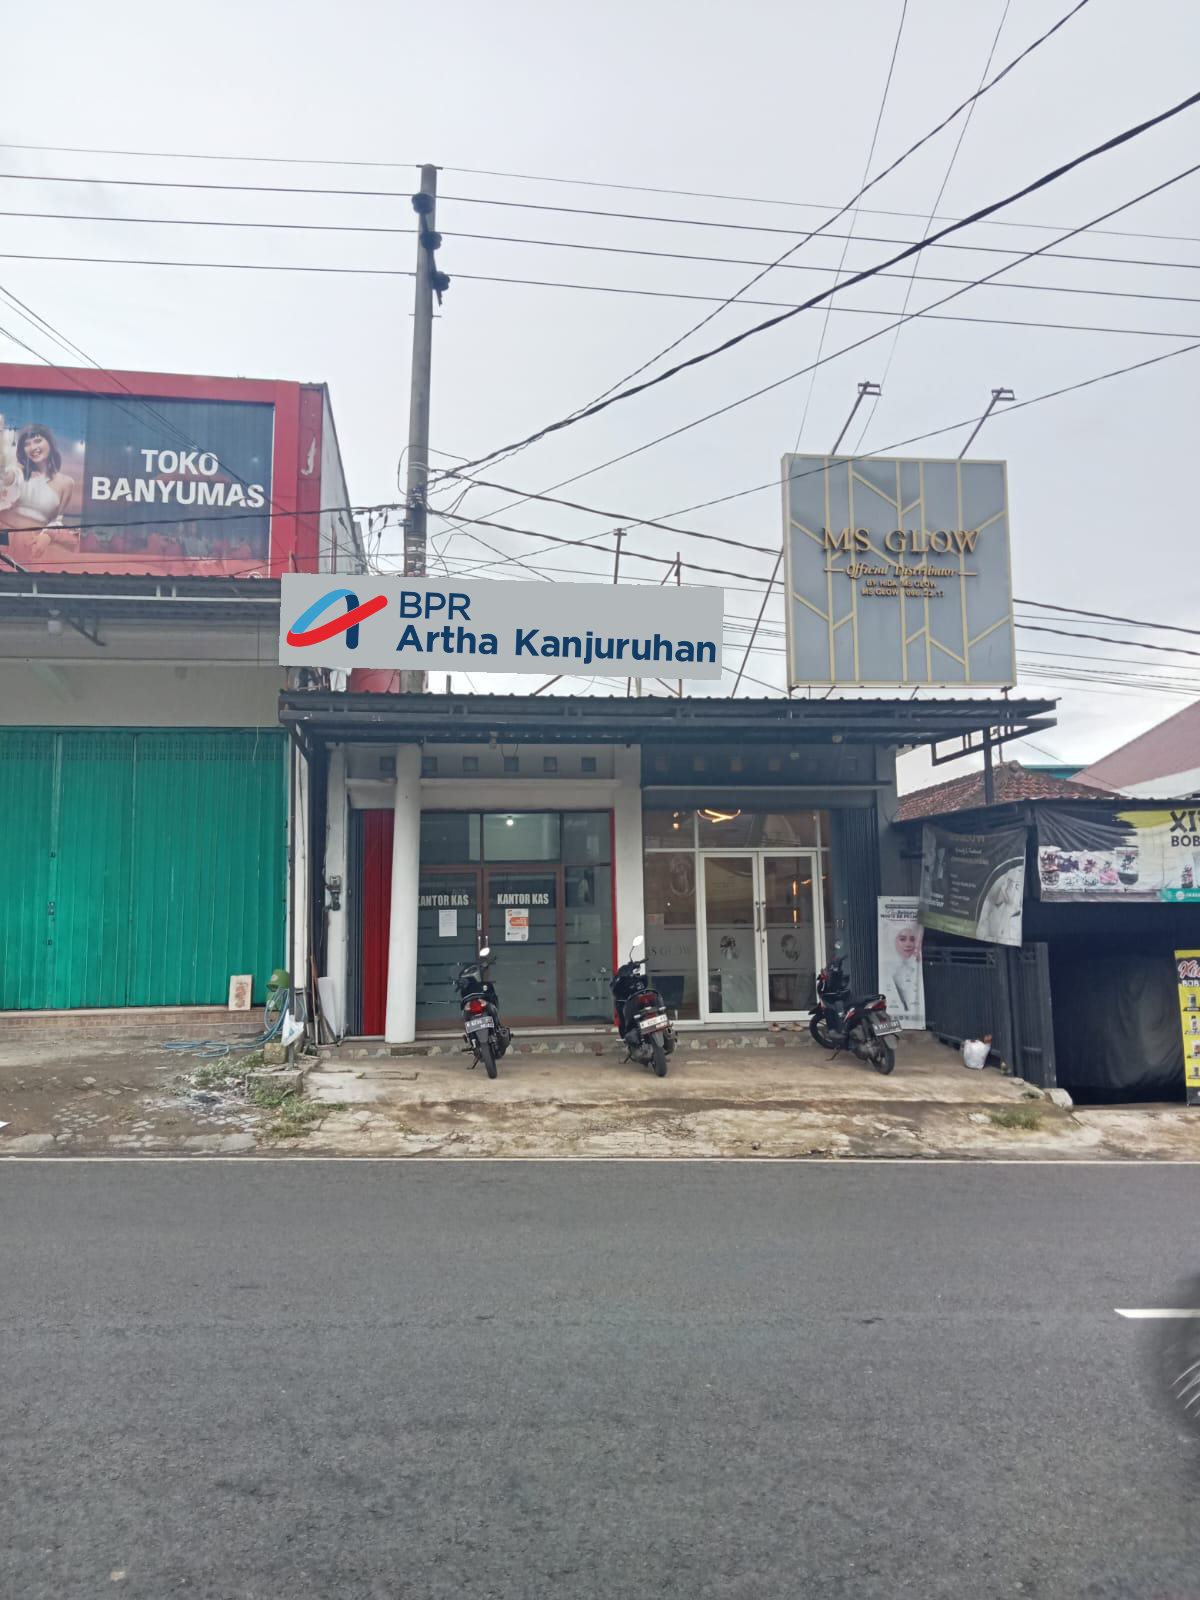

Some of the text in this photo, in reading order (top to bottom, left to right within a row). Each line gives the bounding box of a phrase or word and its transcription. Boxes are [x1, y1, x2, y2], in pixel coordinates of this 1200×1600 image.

[141, 448, 219, 475] TOKO
[91, 476, 265, 508] BANYUMAS
[822, 527, 980, 553] MS GLOW
[846, 562, 889, 579] Official
[399, 591, 471, 621] BPR
[396, 625, 717, 664] Artha Kanjuruhan
[1169, 810, 1200, 832] XI
[451, 894, 469, 906] KAS
[497, 893, 549, 905] KANTOR KAS
